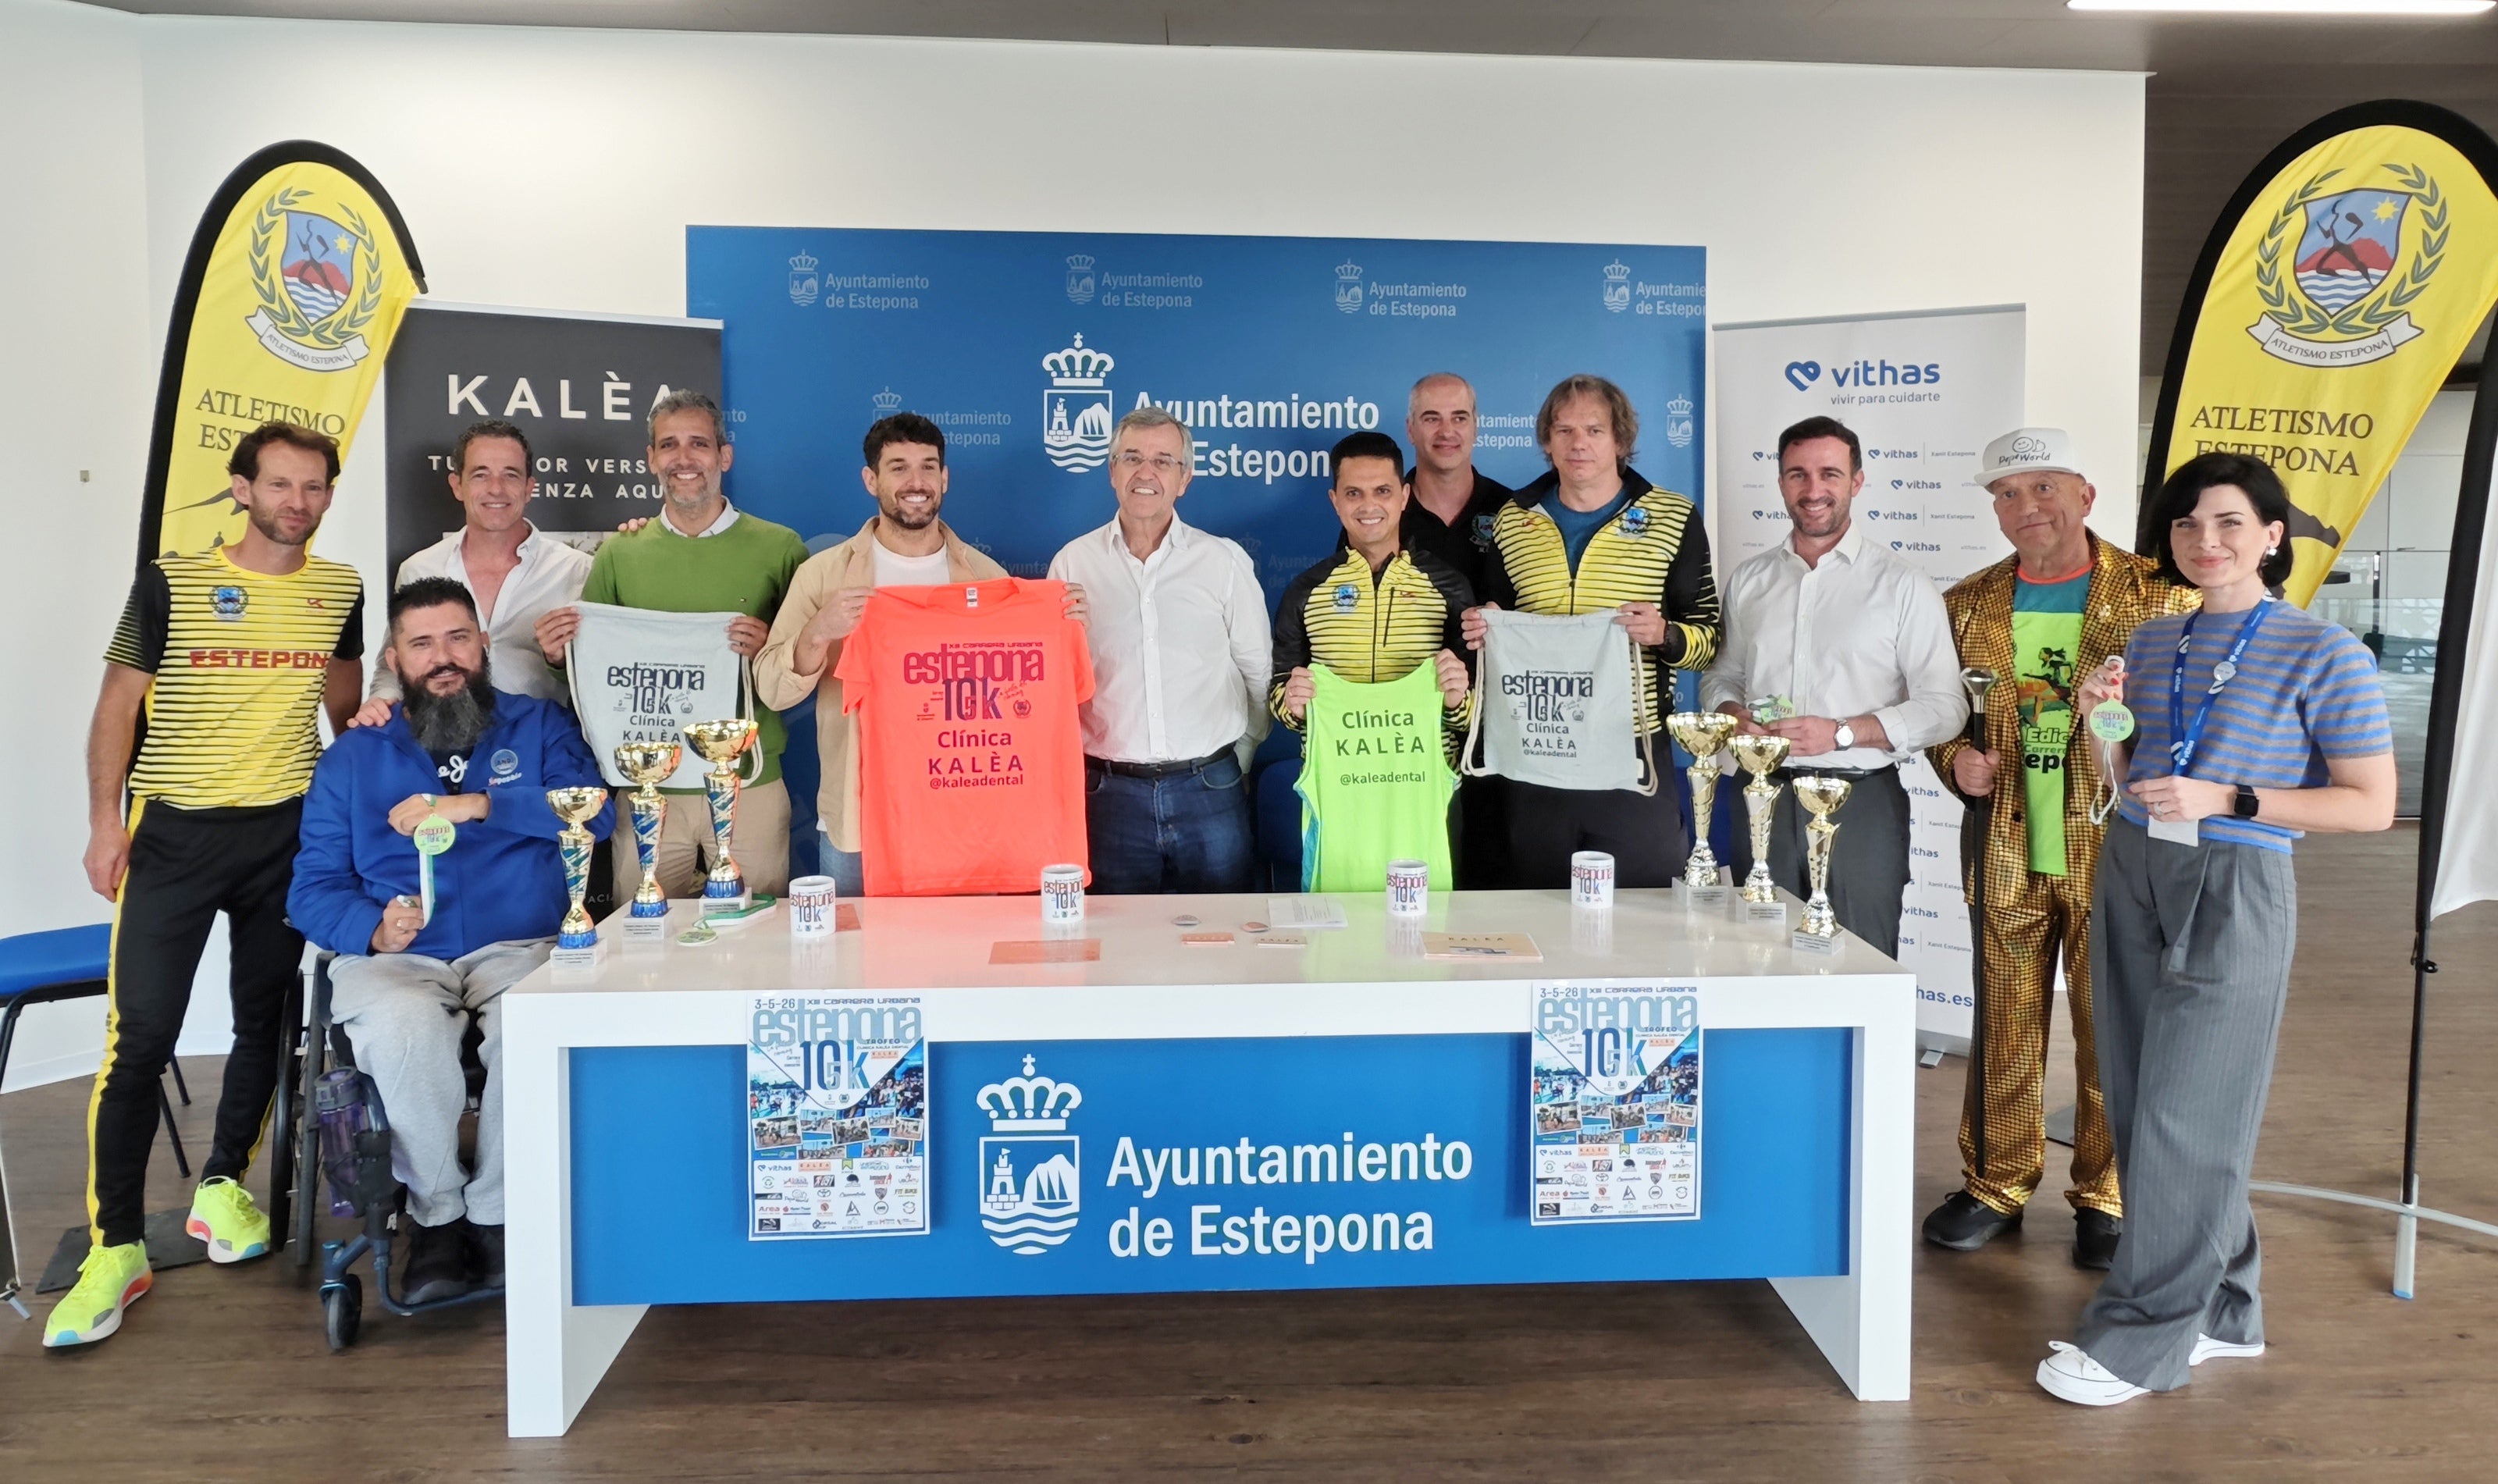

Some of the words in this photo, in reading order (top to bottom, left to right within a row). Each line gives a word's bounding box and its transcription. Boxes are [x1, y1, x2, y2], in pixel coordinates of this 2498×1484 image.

[825, 273, 929, 291] Ayuntamiento
[1101, 272, 1203, 290] Ayuntamiento
[1369, 281, 1467, 299] Ayuntamiento
[1635, 281, 1706, 299] Ayuntamie
[826, 293, 844, 308] de
[849, 294, 919, 311] Estepona
[1101, 292, 1120, 306] de
[1124, 291, 1192, 309] Estepona
[1369, 301, 1387, 315] de
[1391, 301, 1456, 319] Estepona
[1635, 300, 1653, 315] de
[1656, 301, 1706, 319] Estepo
[267, 334, 308, 361] ATLETISMO
[311, 354, 349, 365] ESTEPONA
[2271, 338, 2327, 359] ATLETISMO
[2329, 340, 2389, 359] ESTEPONA
[1831, 359, 1941, 387] vithas
[1831, 394, 1856, 405] vivir
[1858, 393, 1885, 406] para
[1888, 392, 1941, 403] cuidarte
[195, 389, 345, 435] ATLETISMO
[912, 410, 1012, 426] untamiento
[2190, 405, 2374, 439] ATLETISMO
[942, 431, 1000, 448] stepona
[1472, 433, 1532, 450] stepona
[1191, 440, 1330, 486] Estepon
[1884, 449, 1918, 459] vithas
[585, 459, 646, 474] VERS
[531, 482, 593, 498] ENZA
[615, 484, 664, 500] AQU
[1906, 480, 1941, 489] vithas
[1767, 511, 1792, 520] vitha
[1884, 511, 1918, 521] vithas
[1906, 542, 1941, 552] vithas
[190, 649, 328, 669] ESTEPON
[629, 715, 675, 727] Clínica
[1342, 710, 1414, 729] Clínica
[1526, 723, 1569, 734] Clínica
[623, 729, 681, 742] KALÈA
[938, 729, 1012, 748] Clínica
[1336, 732, 1425, 756] KALÈA
[1521, 737, 1576, 749] KALÈA
[2026, 727, 2069, 744] Edic
[929, 751, 1023, 775] KALÈA
[930, 774, 1023, 789] @kaleadental
[1340, 771, 1425, 785] @kaleadental
[1911, 847, 1939, 858] ithas
[1903, 906, 1938, 918] vithas
[1540, 988, 1578, 998] 3-5-26
[1916, 984, 1973, 1007] has.es
[755, 998, 795, 1009] 3-5-26
[1106, 1132, 1472, 1198] Ayuntamiento
[1108, 1207, 1173, 1258] de
[1191, 1205, 1433, 1265] Estepona
